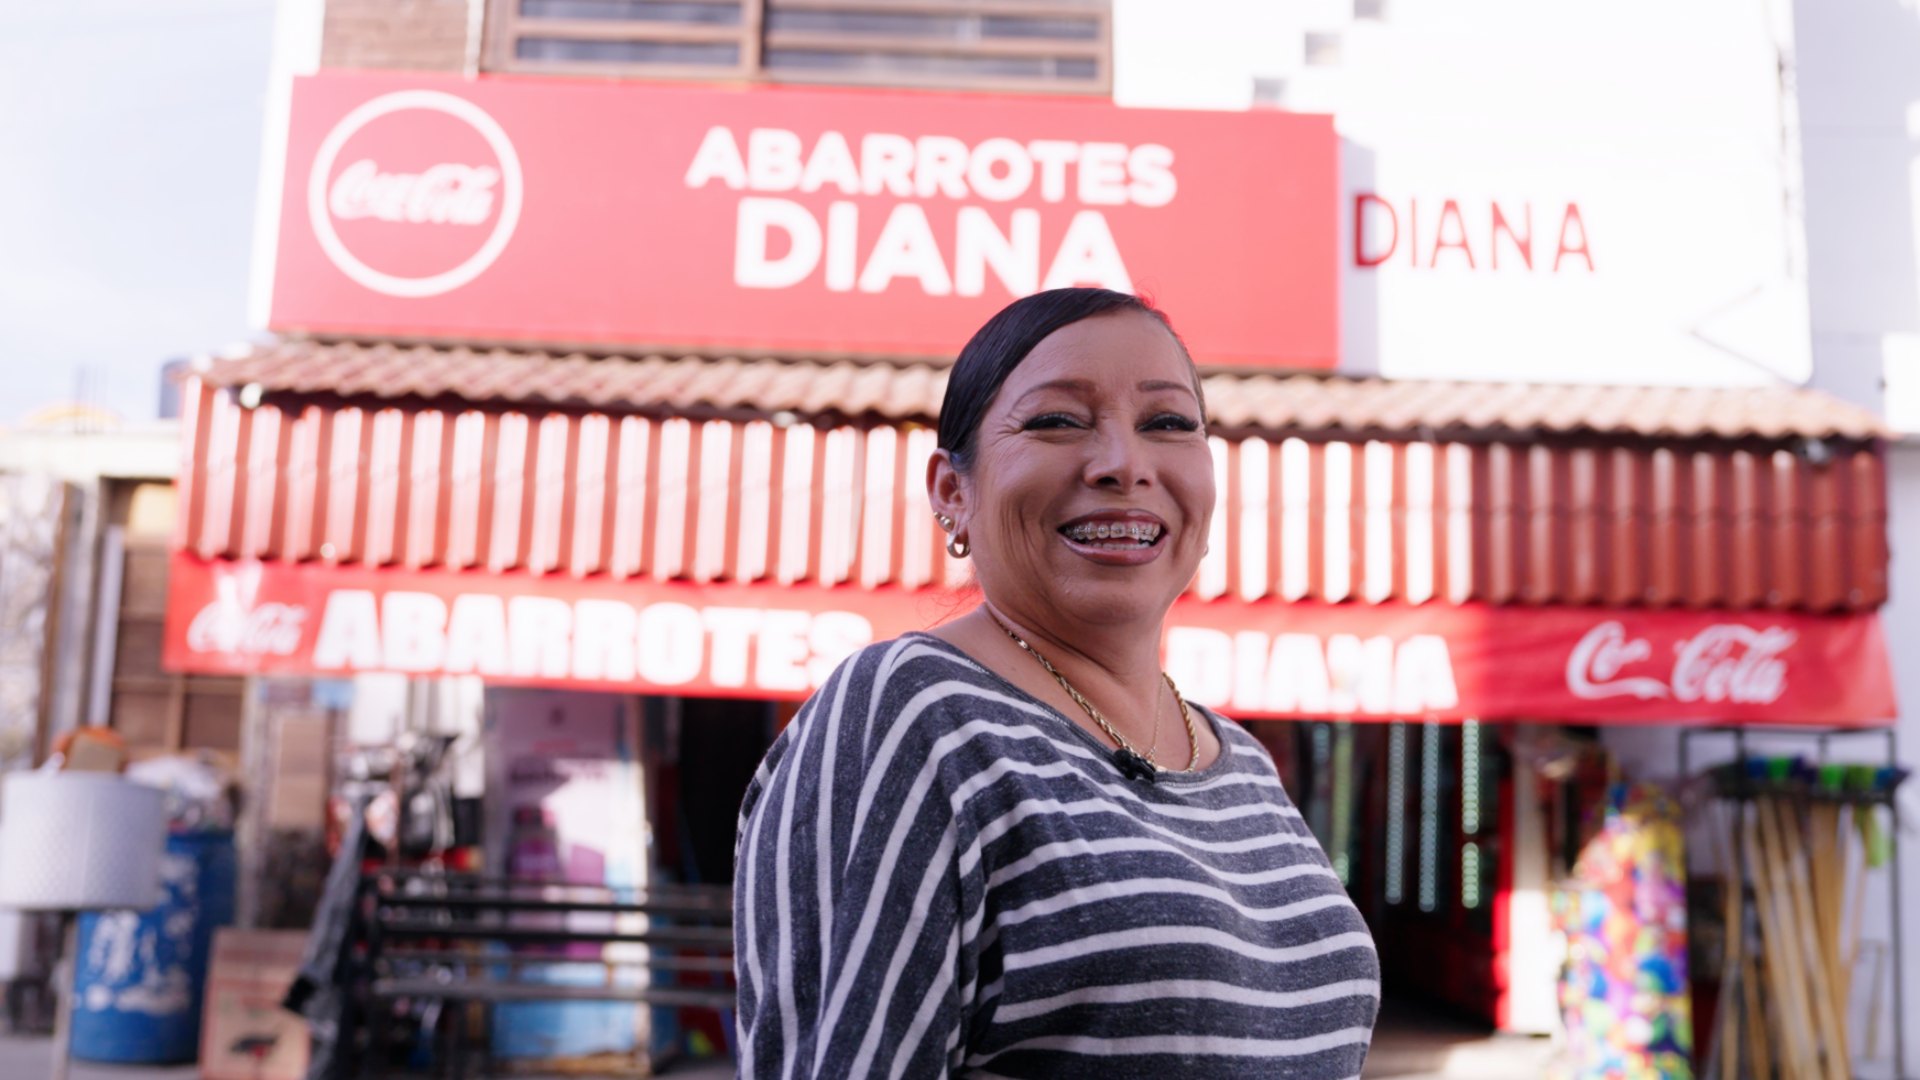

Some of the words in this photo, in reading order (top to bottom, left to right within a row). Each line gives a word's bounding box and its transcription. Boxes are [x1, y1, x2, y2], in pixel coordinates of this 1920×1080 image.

[684, 126, 1177, 207] ABARROTES
[733, 196, 1134, 298] DIANA
[1354, 193, 1595, 273] DIANA
[312, 588, 873, 693] ABARROTES
